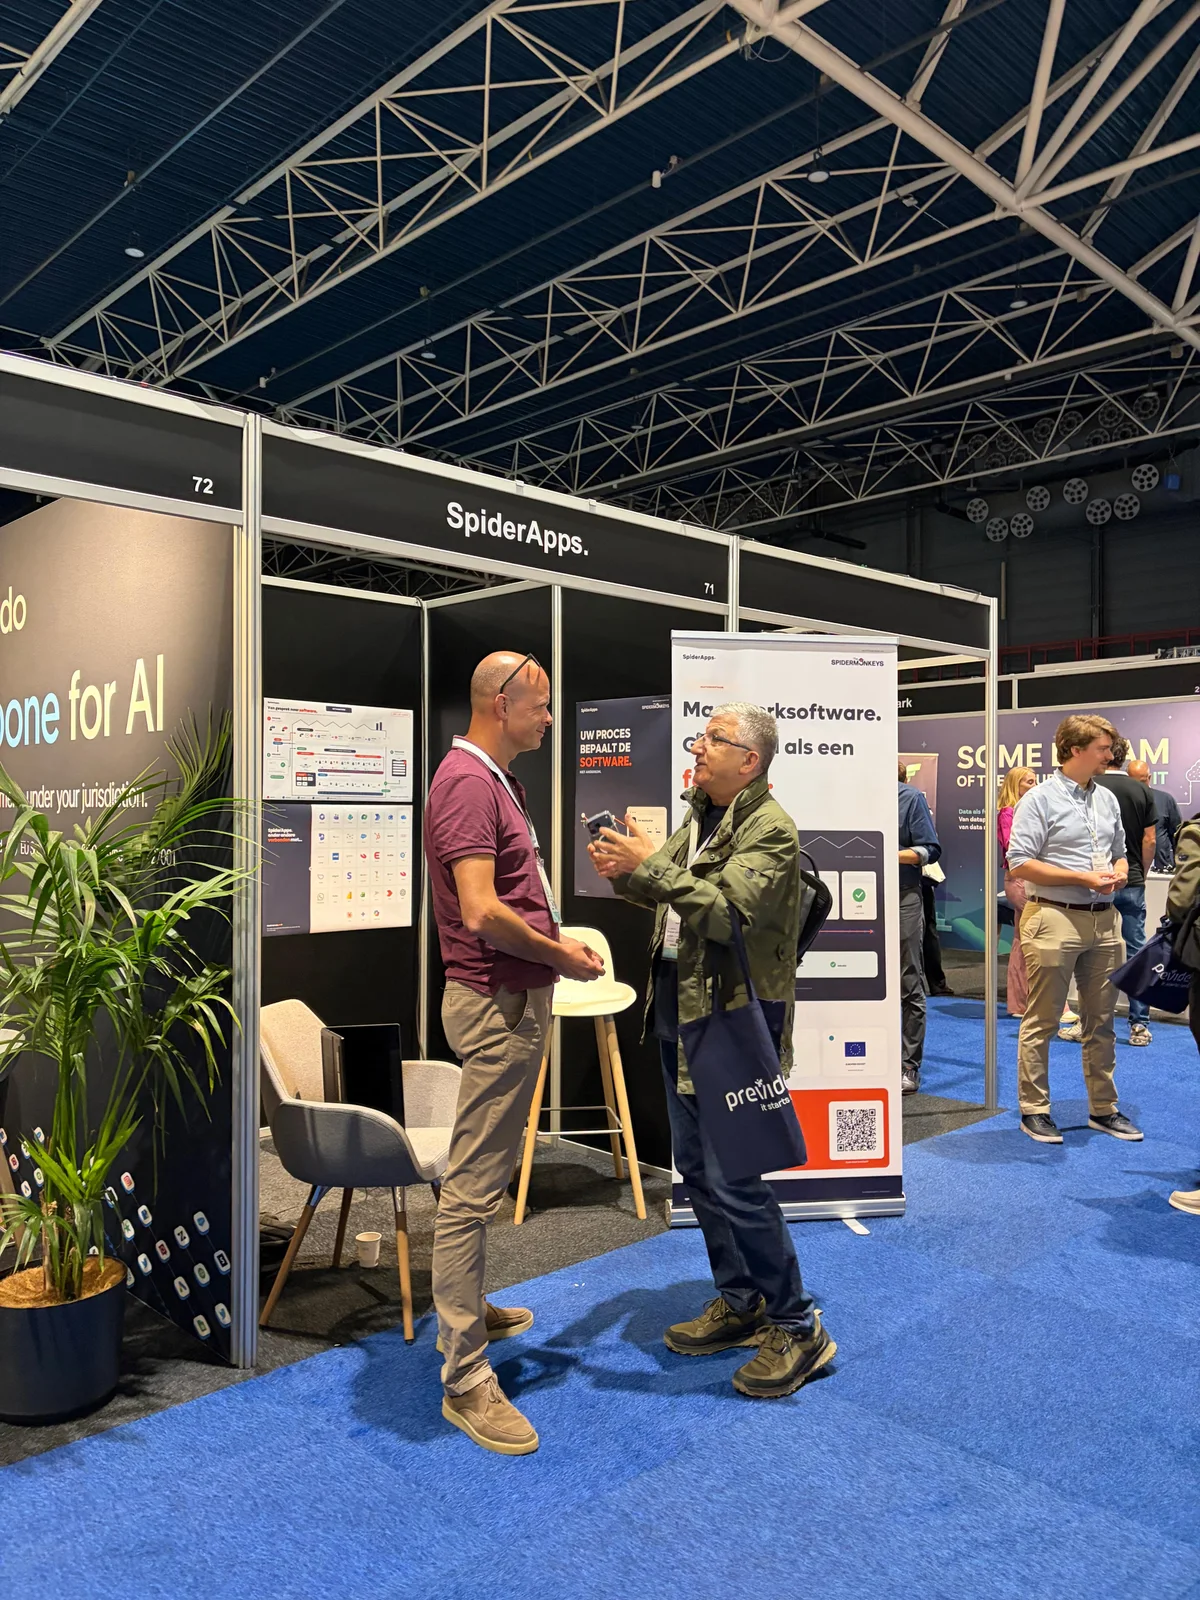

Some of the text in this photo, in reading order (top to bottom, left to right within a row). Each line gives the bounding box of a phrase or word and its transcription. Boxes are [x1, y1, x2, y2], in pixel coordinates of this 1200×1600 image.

[192, 475, 214, 495] 72
[446, 501, 589, 556] SpiderApps.
[704, 582, 714, 595] 71
[830, 657, 885, 667] SPIDERMONKEYS
[0, 653, 164, 748] one for AI
[682, 701, 882, 722] Marksoftware.
[580, 728, 631, 741] UW PROCES
[580, 742, 631, 754] BEPAALT DE
[784, 738, 813, 755] als
[817, 742, 854, 756] een
[579, 755, 632, 768] SOFTWARE.
[956, 774, 976, 787] OF
[26, 784, 55, 809] under
[56, 788, 81, 814] your
[970, 816, 986, 824] datap
[725, 1074, 788, 1112] previd
[760, 1097, 791, 1112] it starts
